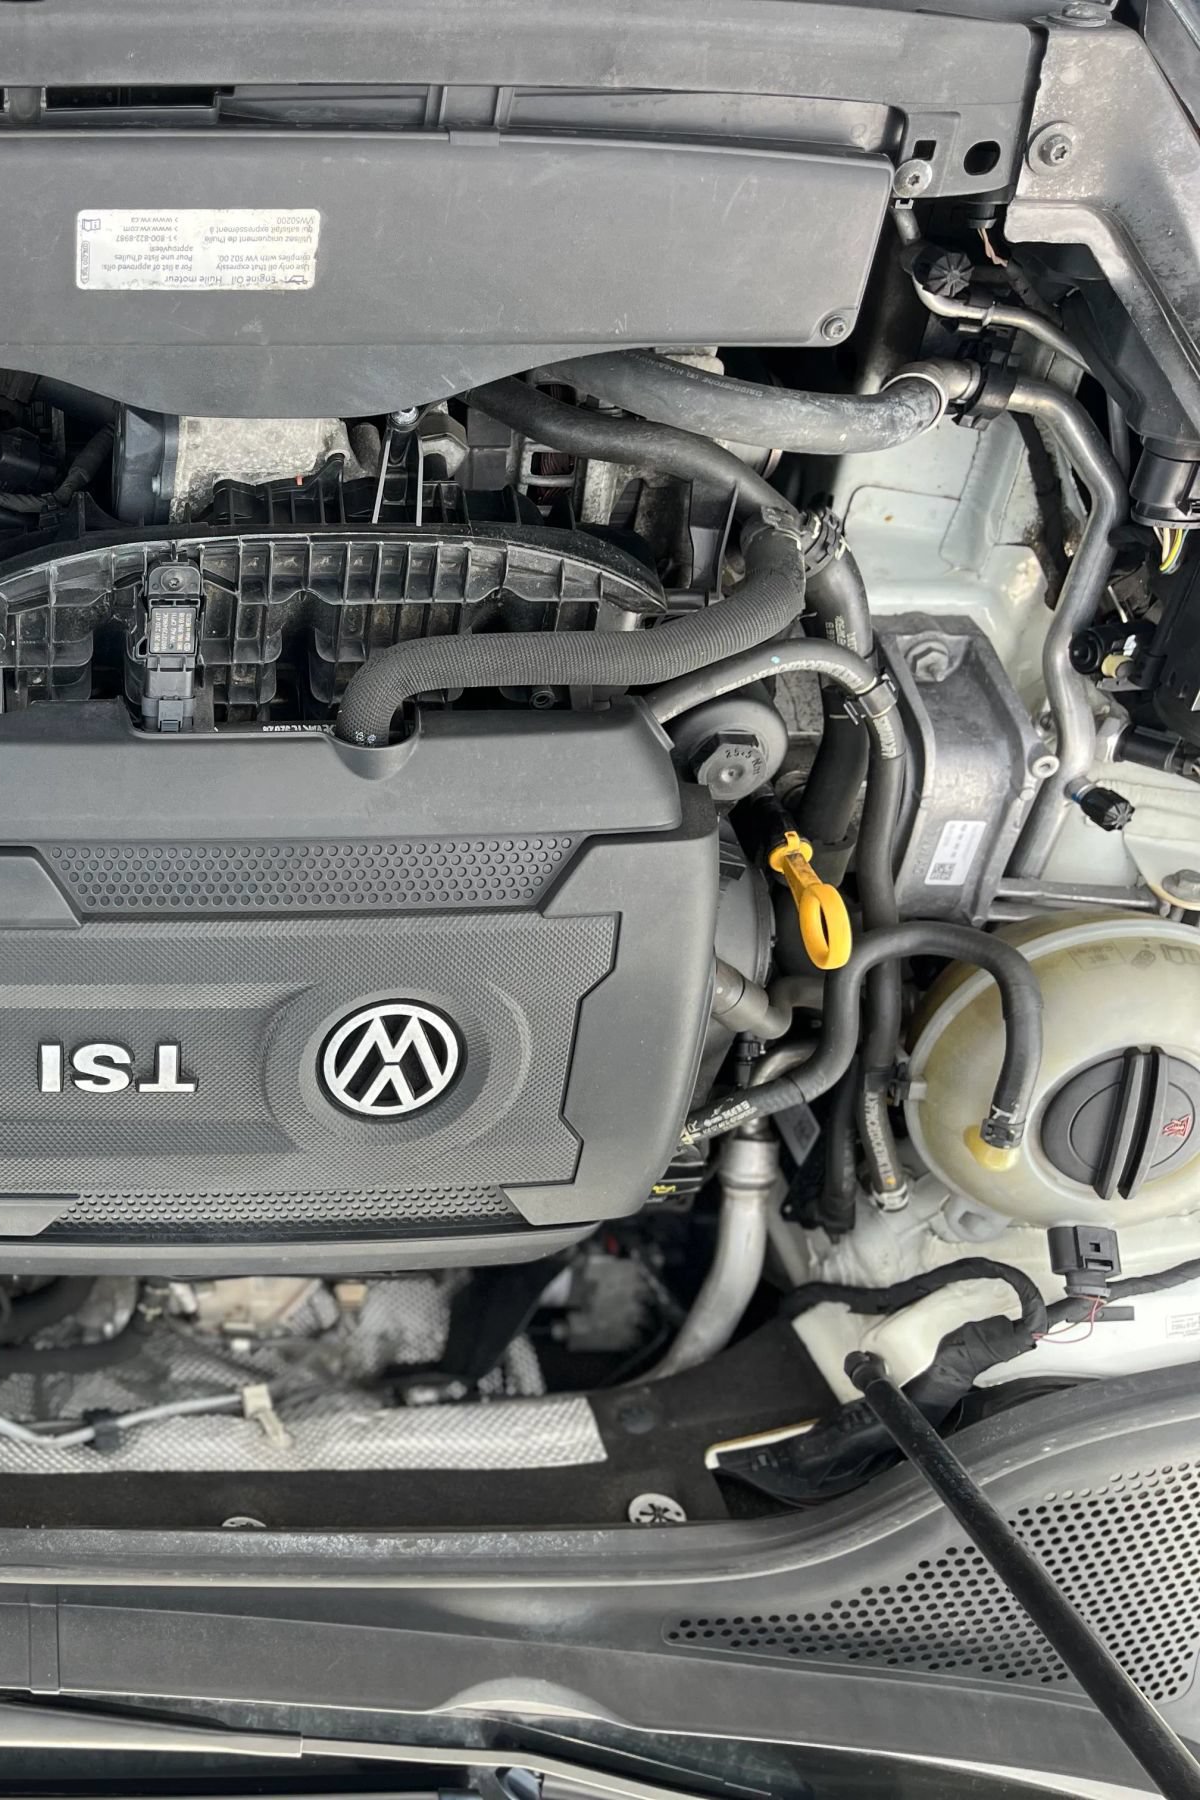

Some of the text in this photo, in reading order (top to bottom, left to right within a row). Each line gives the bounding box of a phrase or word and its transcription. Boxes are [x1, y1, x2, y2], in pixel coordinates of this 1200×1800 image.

[216, 225, 268, 234] expressément
[301, 225, 312, 233] qui
[239, 233, 282, 242] uniquement
[278, 252, 310, 261] complies
[117, 262, 151, 271] approved
[216, 262, 249, 270] expressly
[278, 262, 294, 271] only
[164, 275, 222, 283] Huile moteur
[231, 273, 275, 284] Engine Oil
[40, 1041, 198, 1093] TSI
